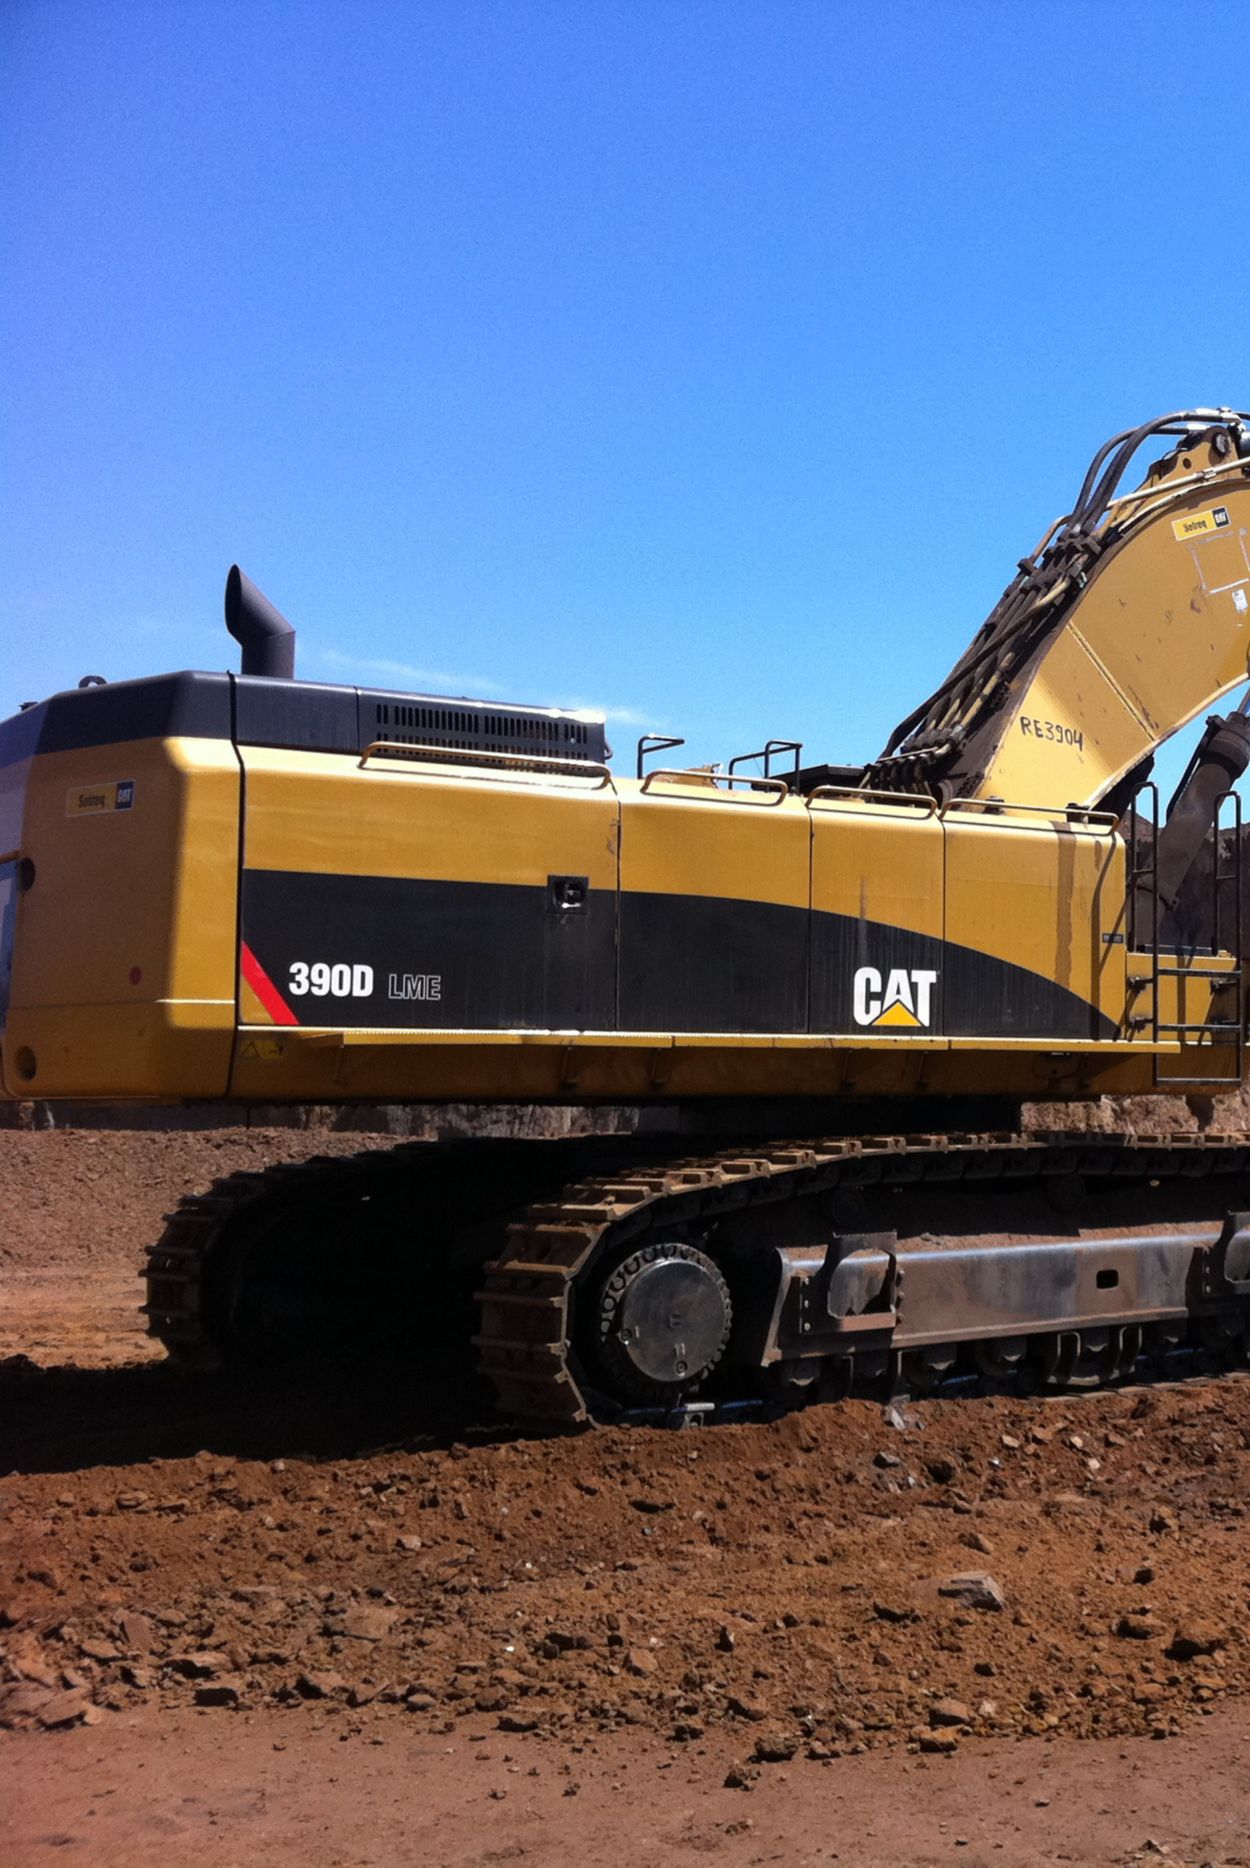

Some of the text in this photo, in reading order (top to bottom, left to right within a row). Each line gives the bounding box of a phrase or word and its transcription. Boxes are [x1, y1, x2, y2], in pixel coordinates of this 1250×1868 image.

[1020, 716, 1083, 752] RE3904
[117, 788, 132, 803] CAT
[289, 962, 441, 1001] 390D LME
[853, 967, 937, 1027] CAT
